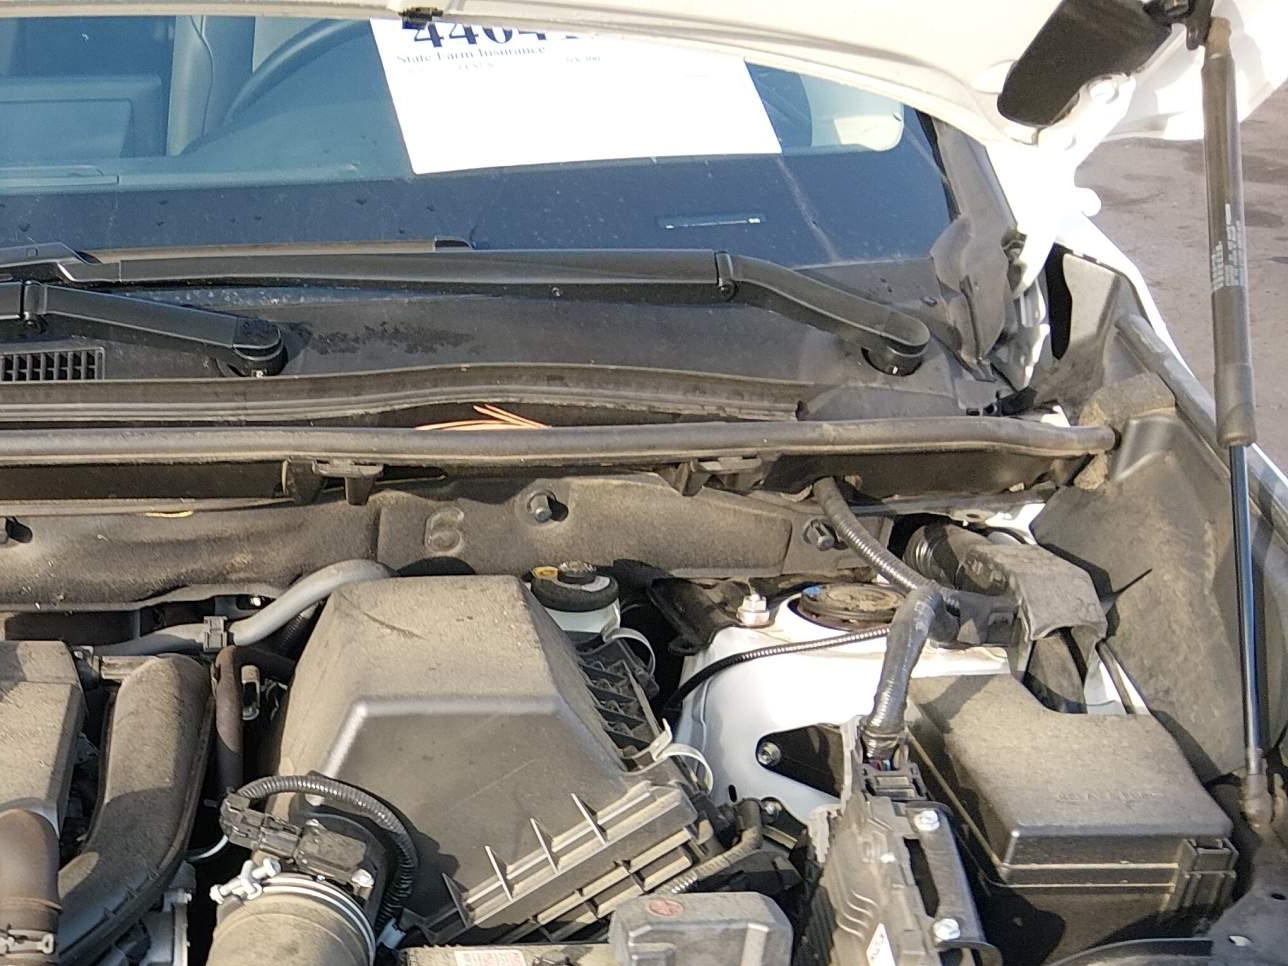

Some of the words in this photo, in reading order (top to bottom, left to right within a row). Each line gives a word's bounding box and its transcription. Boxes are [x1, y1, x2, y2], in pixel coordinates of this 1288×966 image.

[397, 54, 431, 65] State
[436, 51, 474, 61] Farm
[478, 46, 546, 58] Insurance
